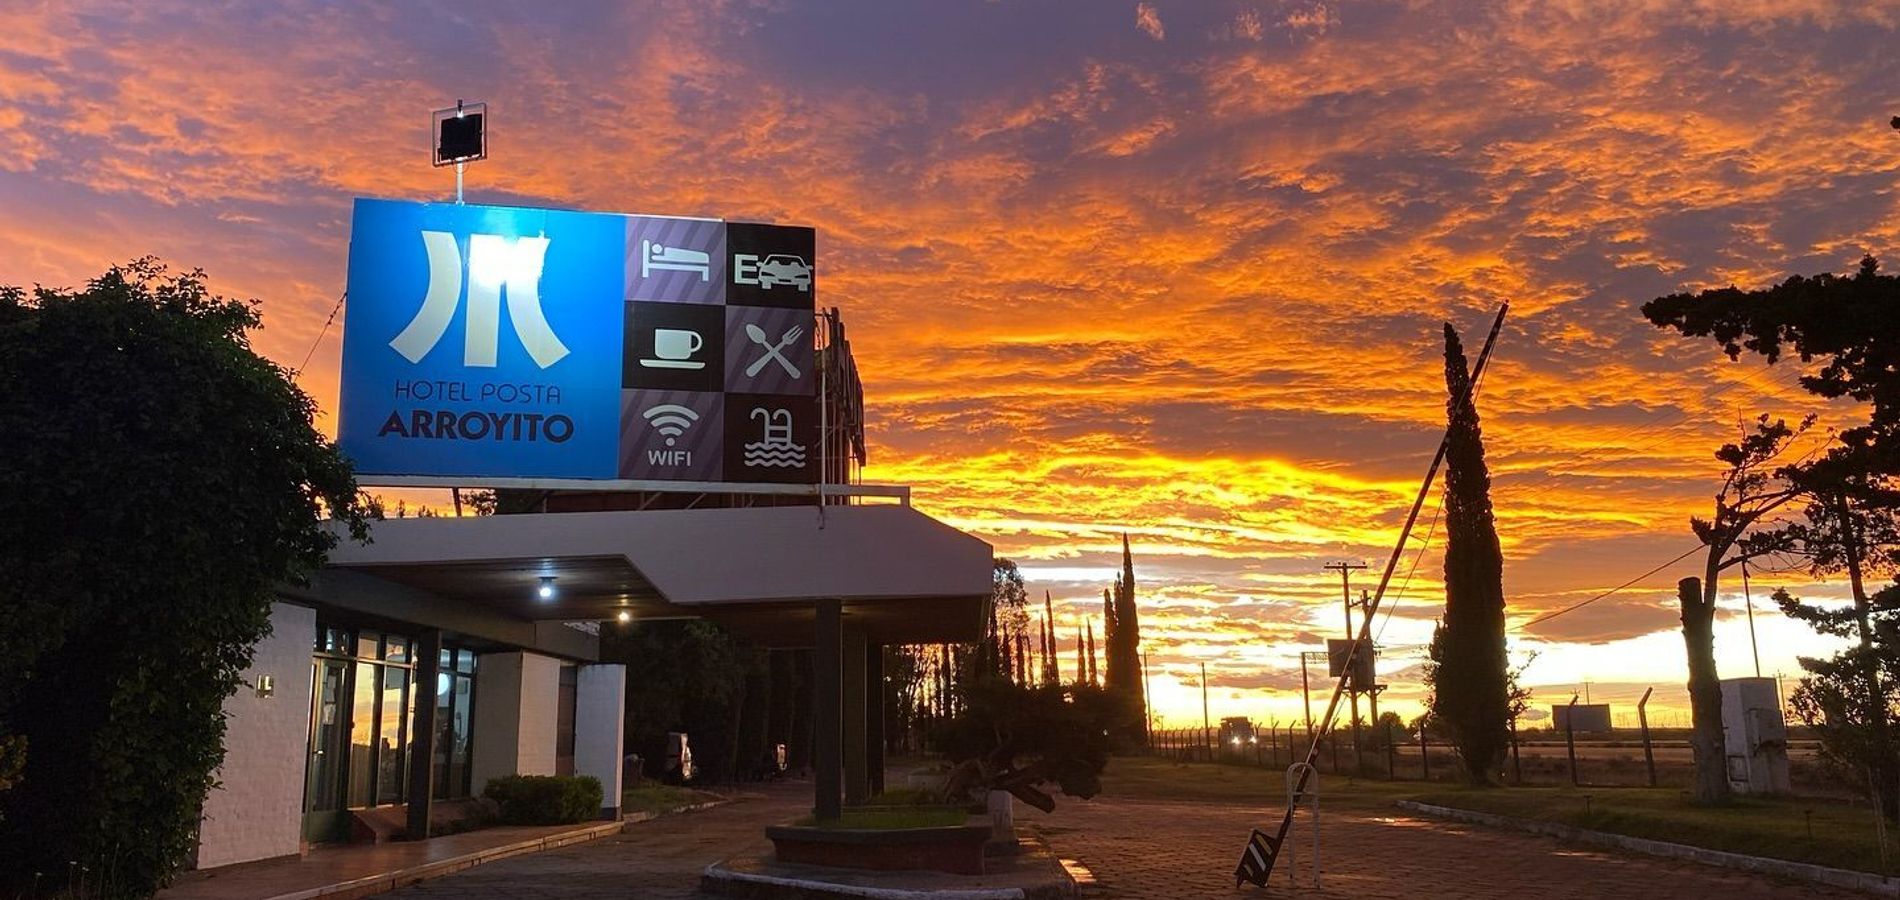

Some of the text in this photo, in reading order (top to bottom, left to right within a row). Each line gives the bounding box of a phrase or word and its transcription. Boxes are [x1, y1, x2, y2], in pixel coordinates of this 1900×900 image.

[734, 254, 759, 285] E
[395, 379, 561, 404] HOTEL POSTA
[377, 409, 574, 443] ARROYITO
[648, 450, 691, 466] WIFI
